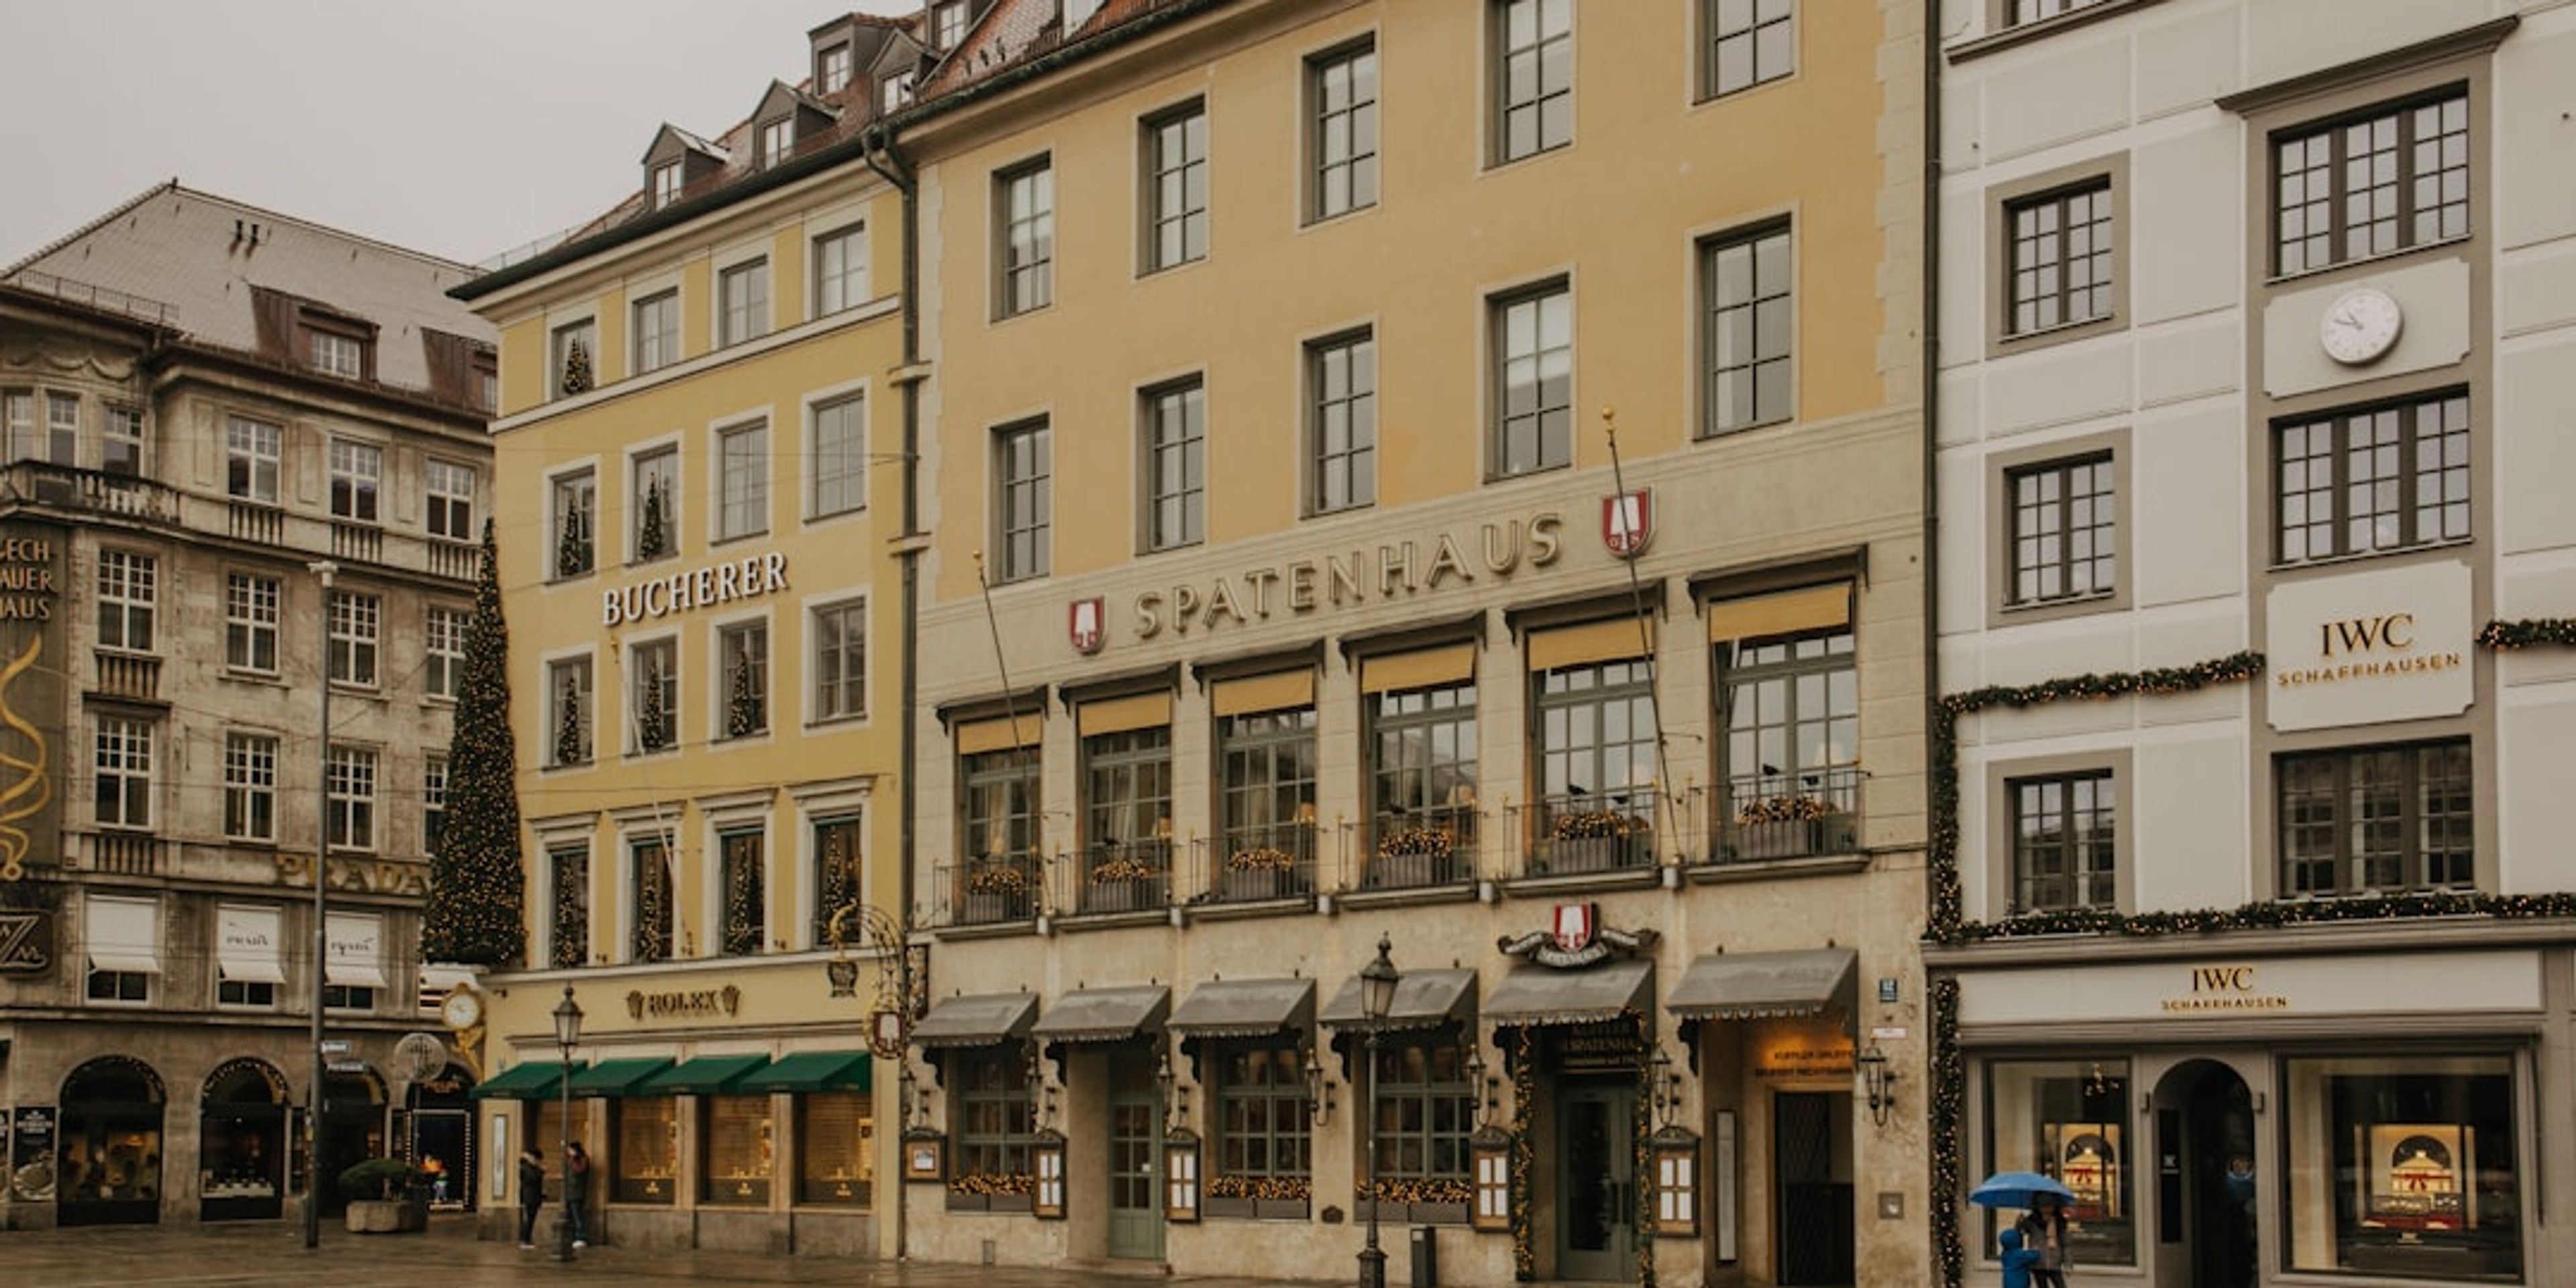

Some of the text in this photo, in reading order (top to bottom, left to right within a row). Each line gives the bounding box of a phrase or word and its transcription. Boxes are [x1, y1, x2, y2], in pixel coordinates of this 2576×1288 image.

[0, 539, 50, 561] ECH
[1133, 512, 1564, 638] SPATENHAUS
[603, 551, 788, 627] BUCHERER
[0, 596, 51, 620] AUS
[2320, 612, 2414, 657] IWC
[2276, 651, 2461, 687] SCHAFFHAUSEN
[2192, 967, 2253, 992] IWC
[648, 989, 720, 1015] ROLEX
[2161, 996, 2288, 1010] SCHAFFHAUSEN
